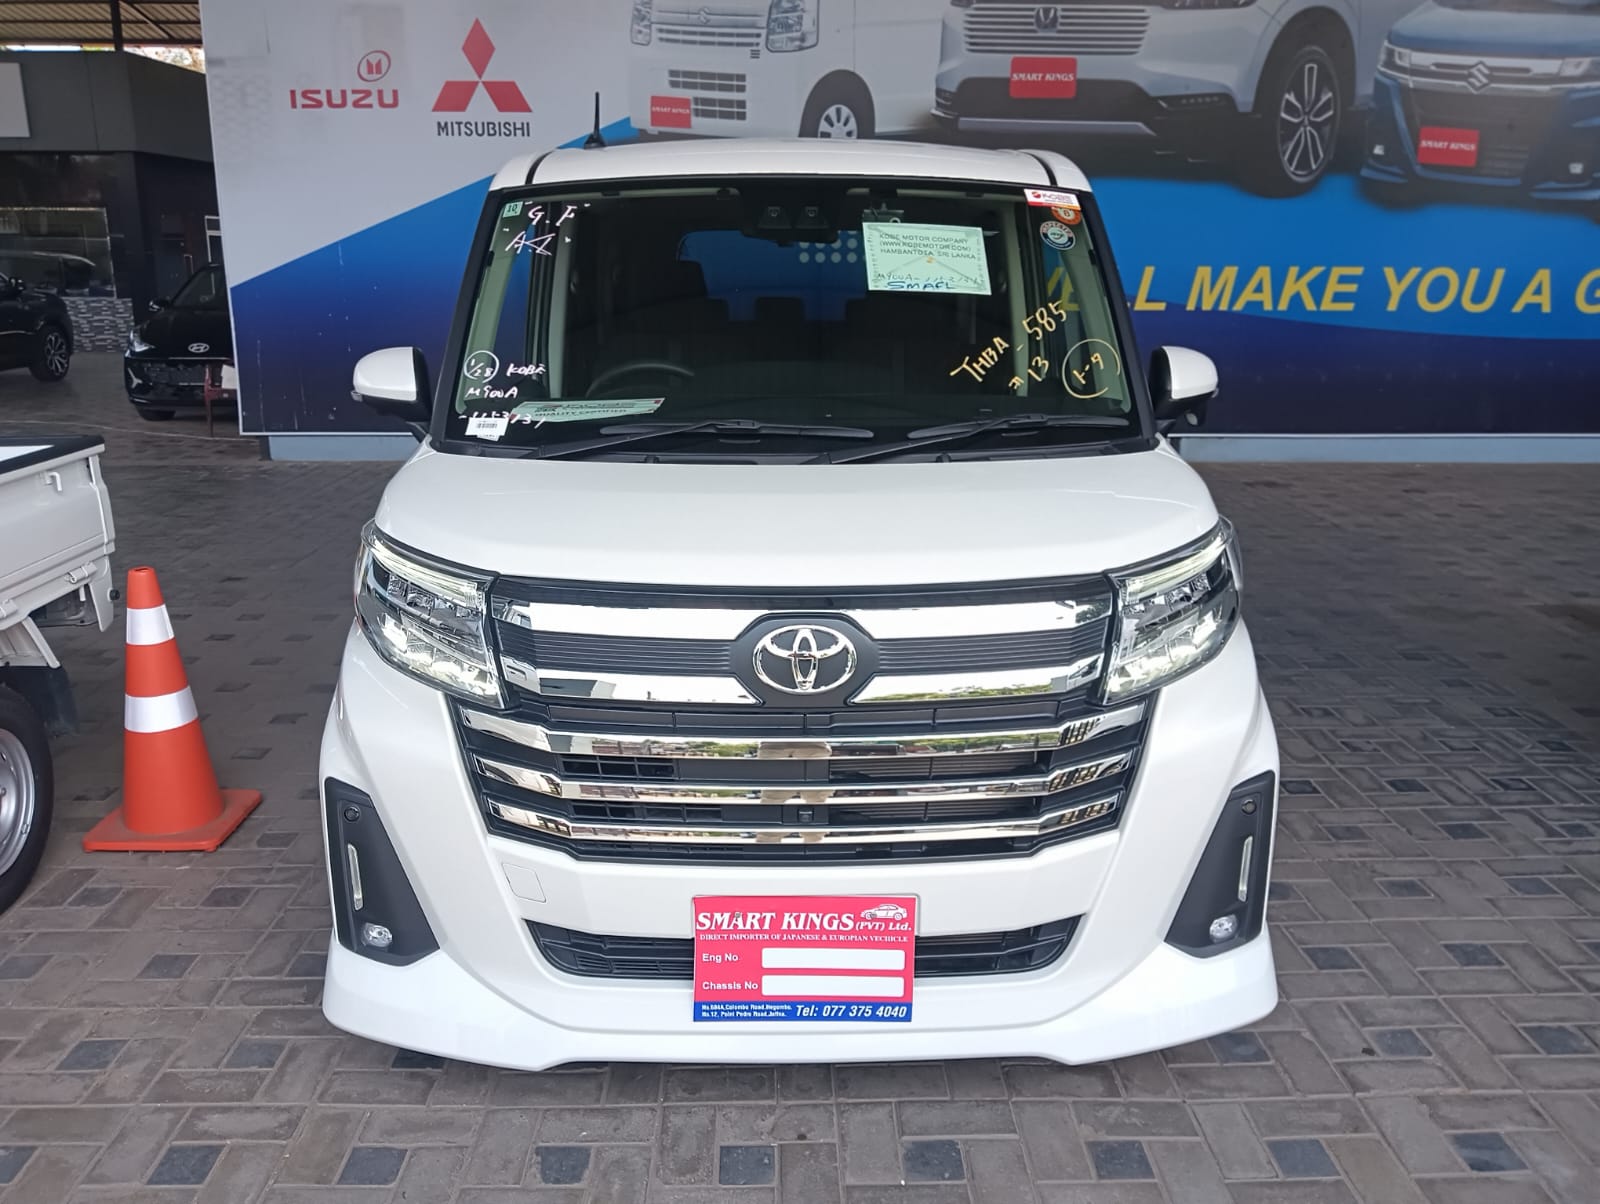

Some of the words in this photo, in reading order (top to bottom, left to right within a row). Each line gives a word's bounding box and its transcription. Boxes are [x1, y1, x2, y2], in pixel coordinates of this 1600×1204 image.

[290, 89, 399, 109] ISUZU
[437, 121, 531, 137] MITSUBISHI
[902, 234, 930, 242] MOTOR
[931, 236, 969, 244] COMPANY
[1186, 266, 1364, 311] MAKE
[1383, 266, 1506, 312] YOU
[1511, 268, 1551, 313] A
[697, 912, 776, 930] SMART
[781, 912, 855, 931] KINGS
[855, 921, 885, 932] (PVT)
[888, 922, 912, 931] Ltd.
[700, 933, 728, 941] DIRECT
[729, 933, 769, 941] IMPORTER
[783, 933, 820, 941] JAPANESE
[829, 934, 868, 942] EUROPIAN
[702, 953, 722, 964] Eng
[724, 953, 739, 961] No
[702, 981, 742, 990] Chassis
[744, 981, 759, 990] No
[796, 1005, 818, 1017] Tel:
[822, 1005, 846, 1017] 077
[849, 1005, 873, 1017] 375
[876, 1006, 907, 1018] 4040
